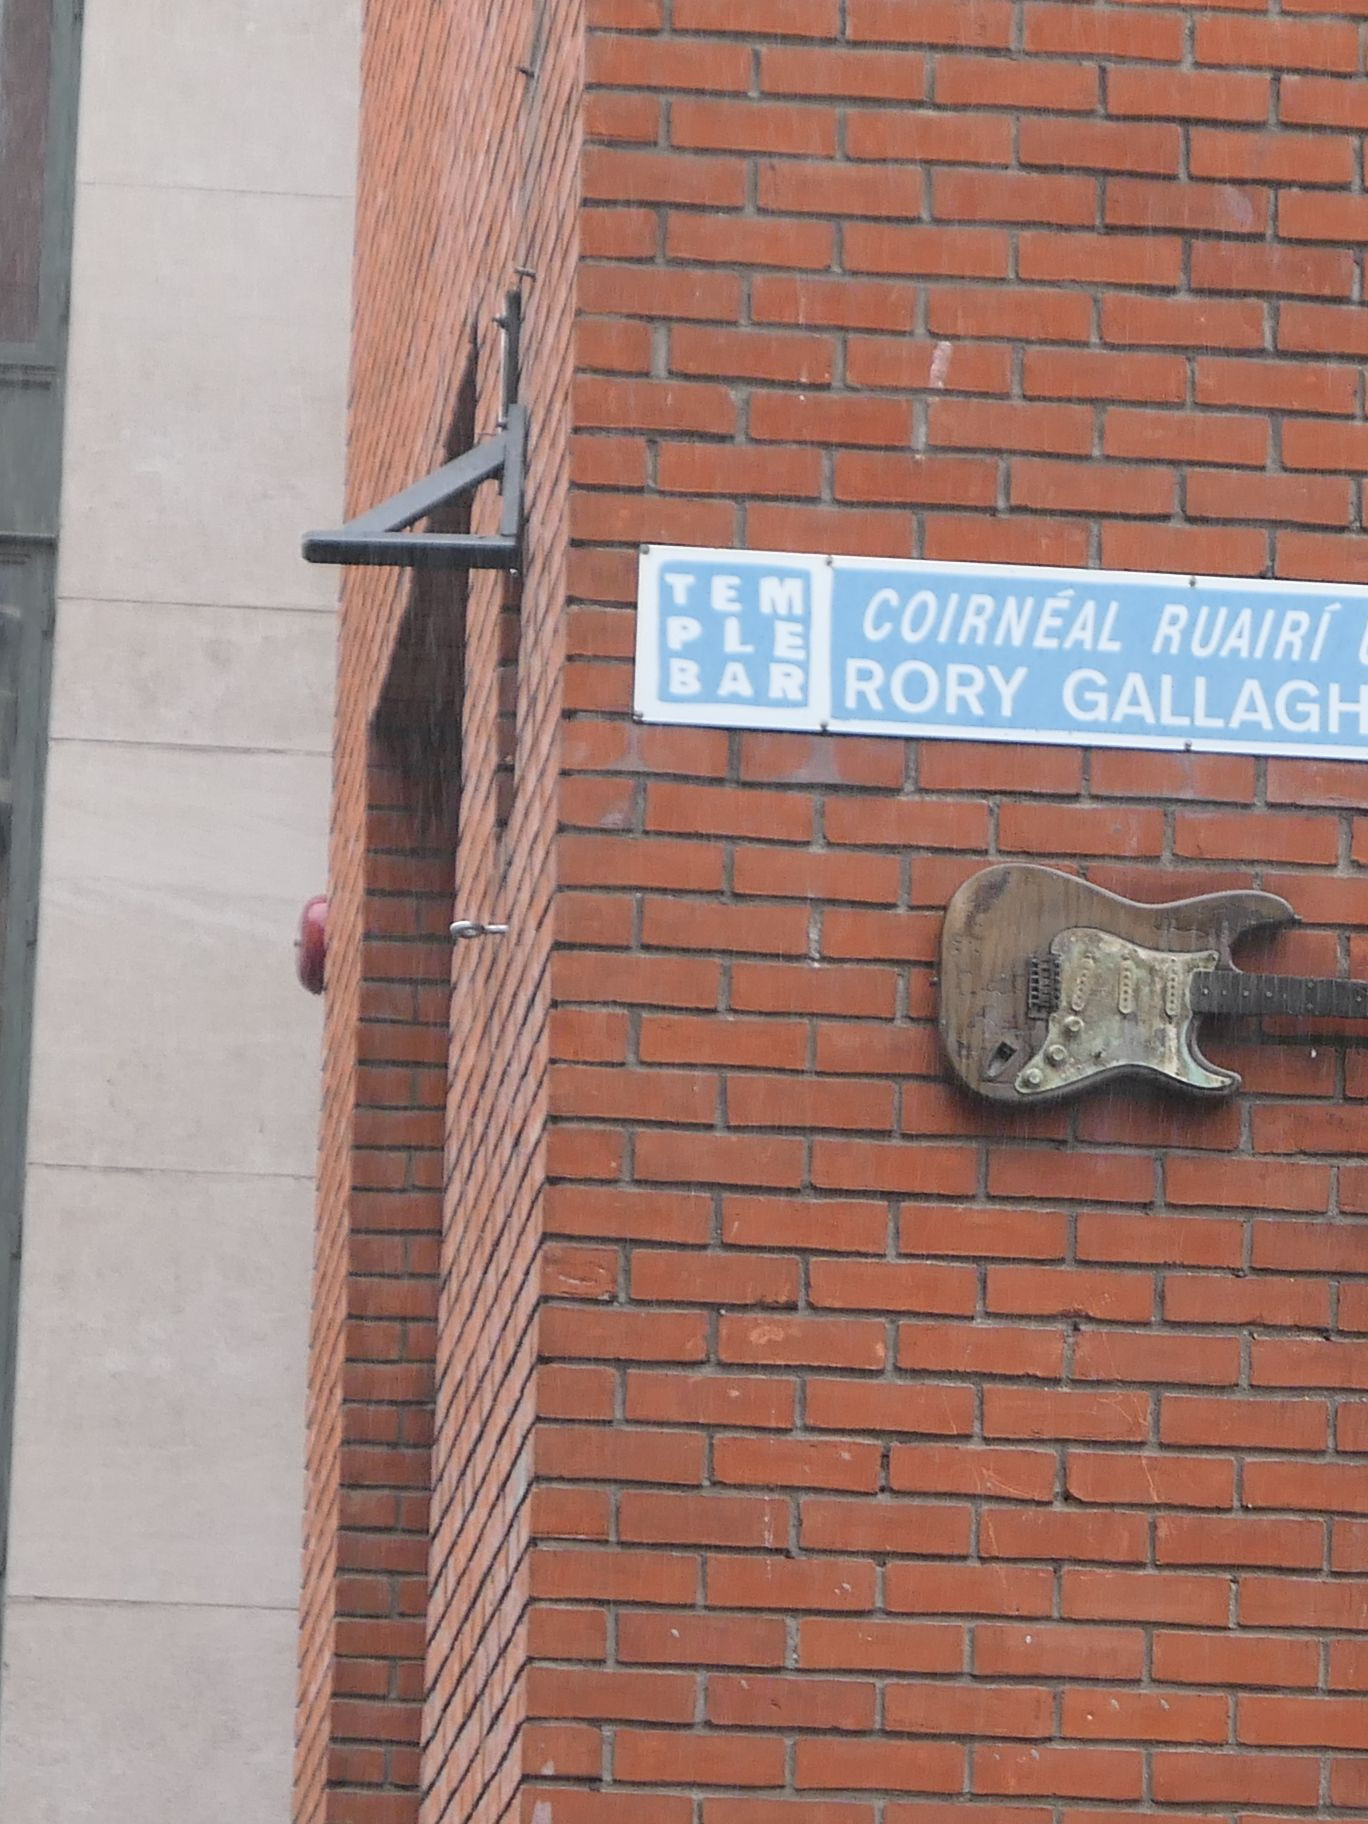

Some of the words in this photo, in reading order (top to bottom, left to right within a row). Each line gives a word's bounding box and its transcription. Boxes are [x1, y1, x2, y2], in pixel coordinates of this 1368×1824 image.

[665, 572, 804, 615] TEM
[666, 615, 806, 660] PLE
[863, 588, 1121, 653] COIRNÉAL
[1152, 602, 1341, 661] RUAIRÍ
[668, 658, 805, 702] BAR
[845, 657, 1029, 718] RORY
